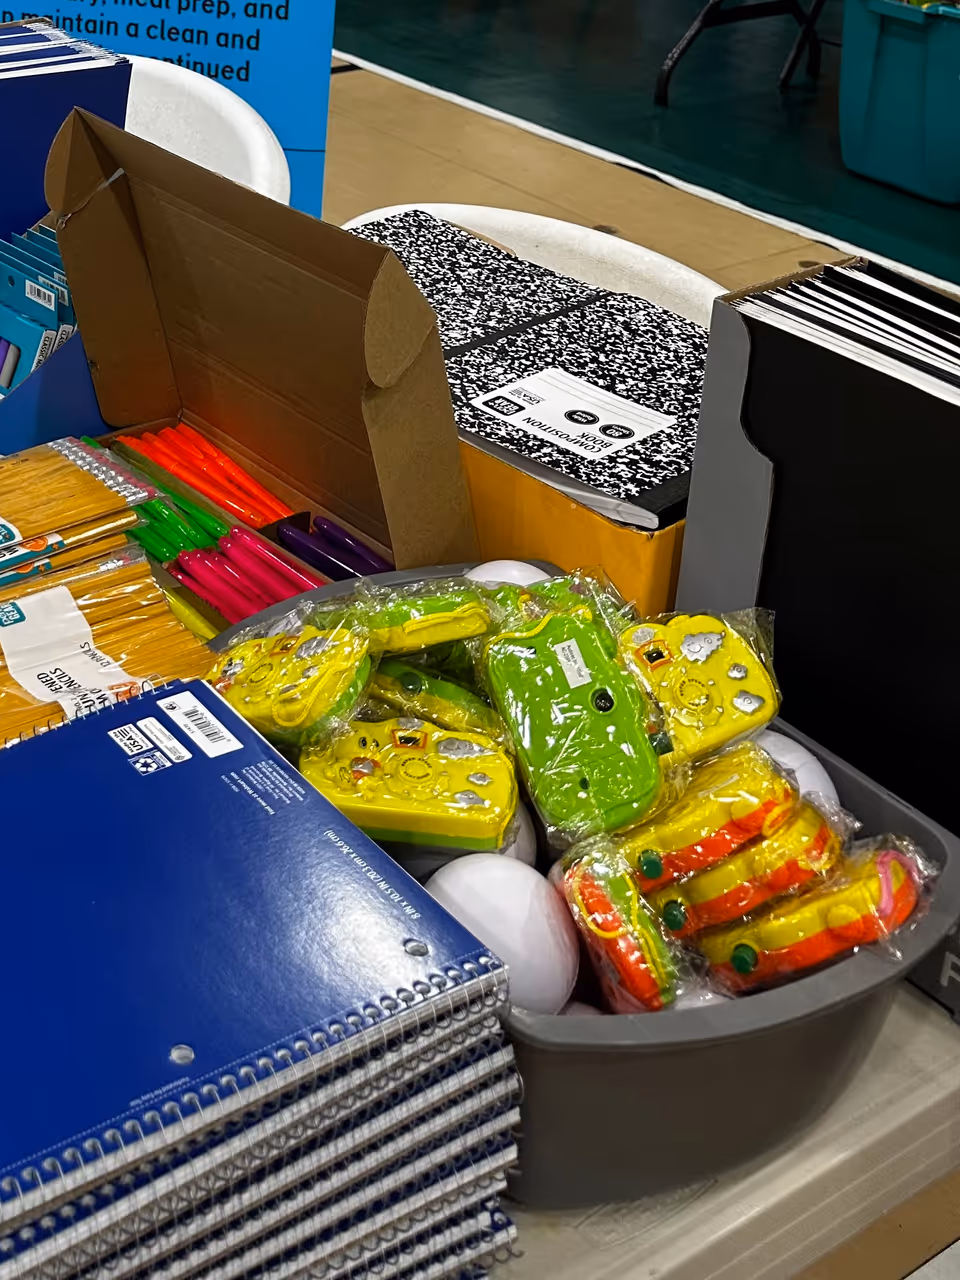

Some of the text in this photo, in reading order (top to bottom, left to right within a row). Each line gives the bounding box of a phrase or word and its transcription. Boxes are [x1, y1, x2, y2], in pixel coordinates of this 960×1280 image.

[126, 23, 139, 38] a
[146, 19, 208, 45] clean
[216, 29, 260, 51] and
[521, 416, 602, 453] COMPOSITION
[576, 432, 615, 449] BOOK
[126, 735, 144, 752] USA
[323, 828, 341, 843] cm)
[335, 839, 353, 855] 26.6
[354, 856, 367, 868] cm
[362, 865, 383, 884] (20.3
[376, 879, 390, 892] IN
[385, 887, 403, 903] 10.5
[404, 905, 416, 916] IN
